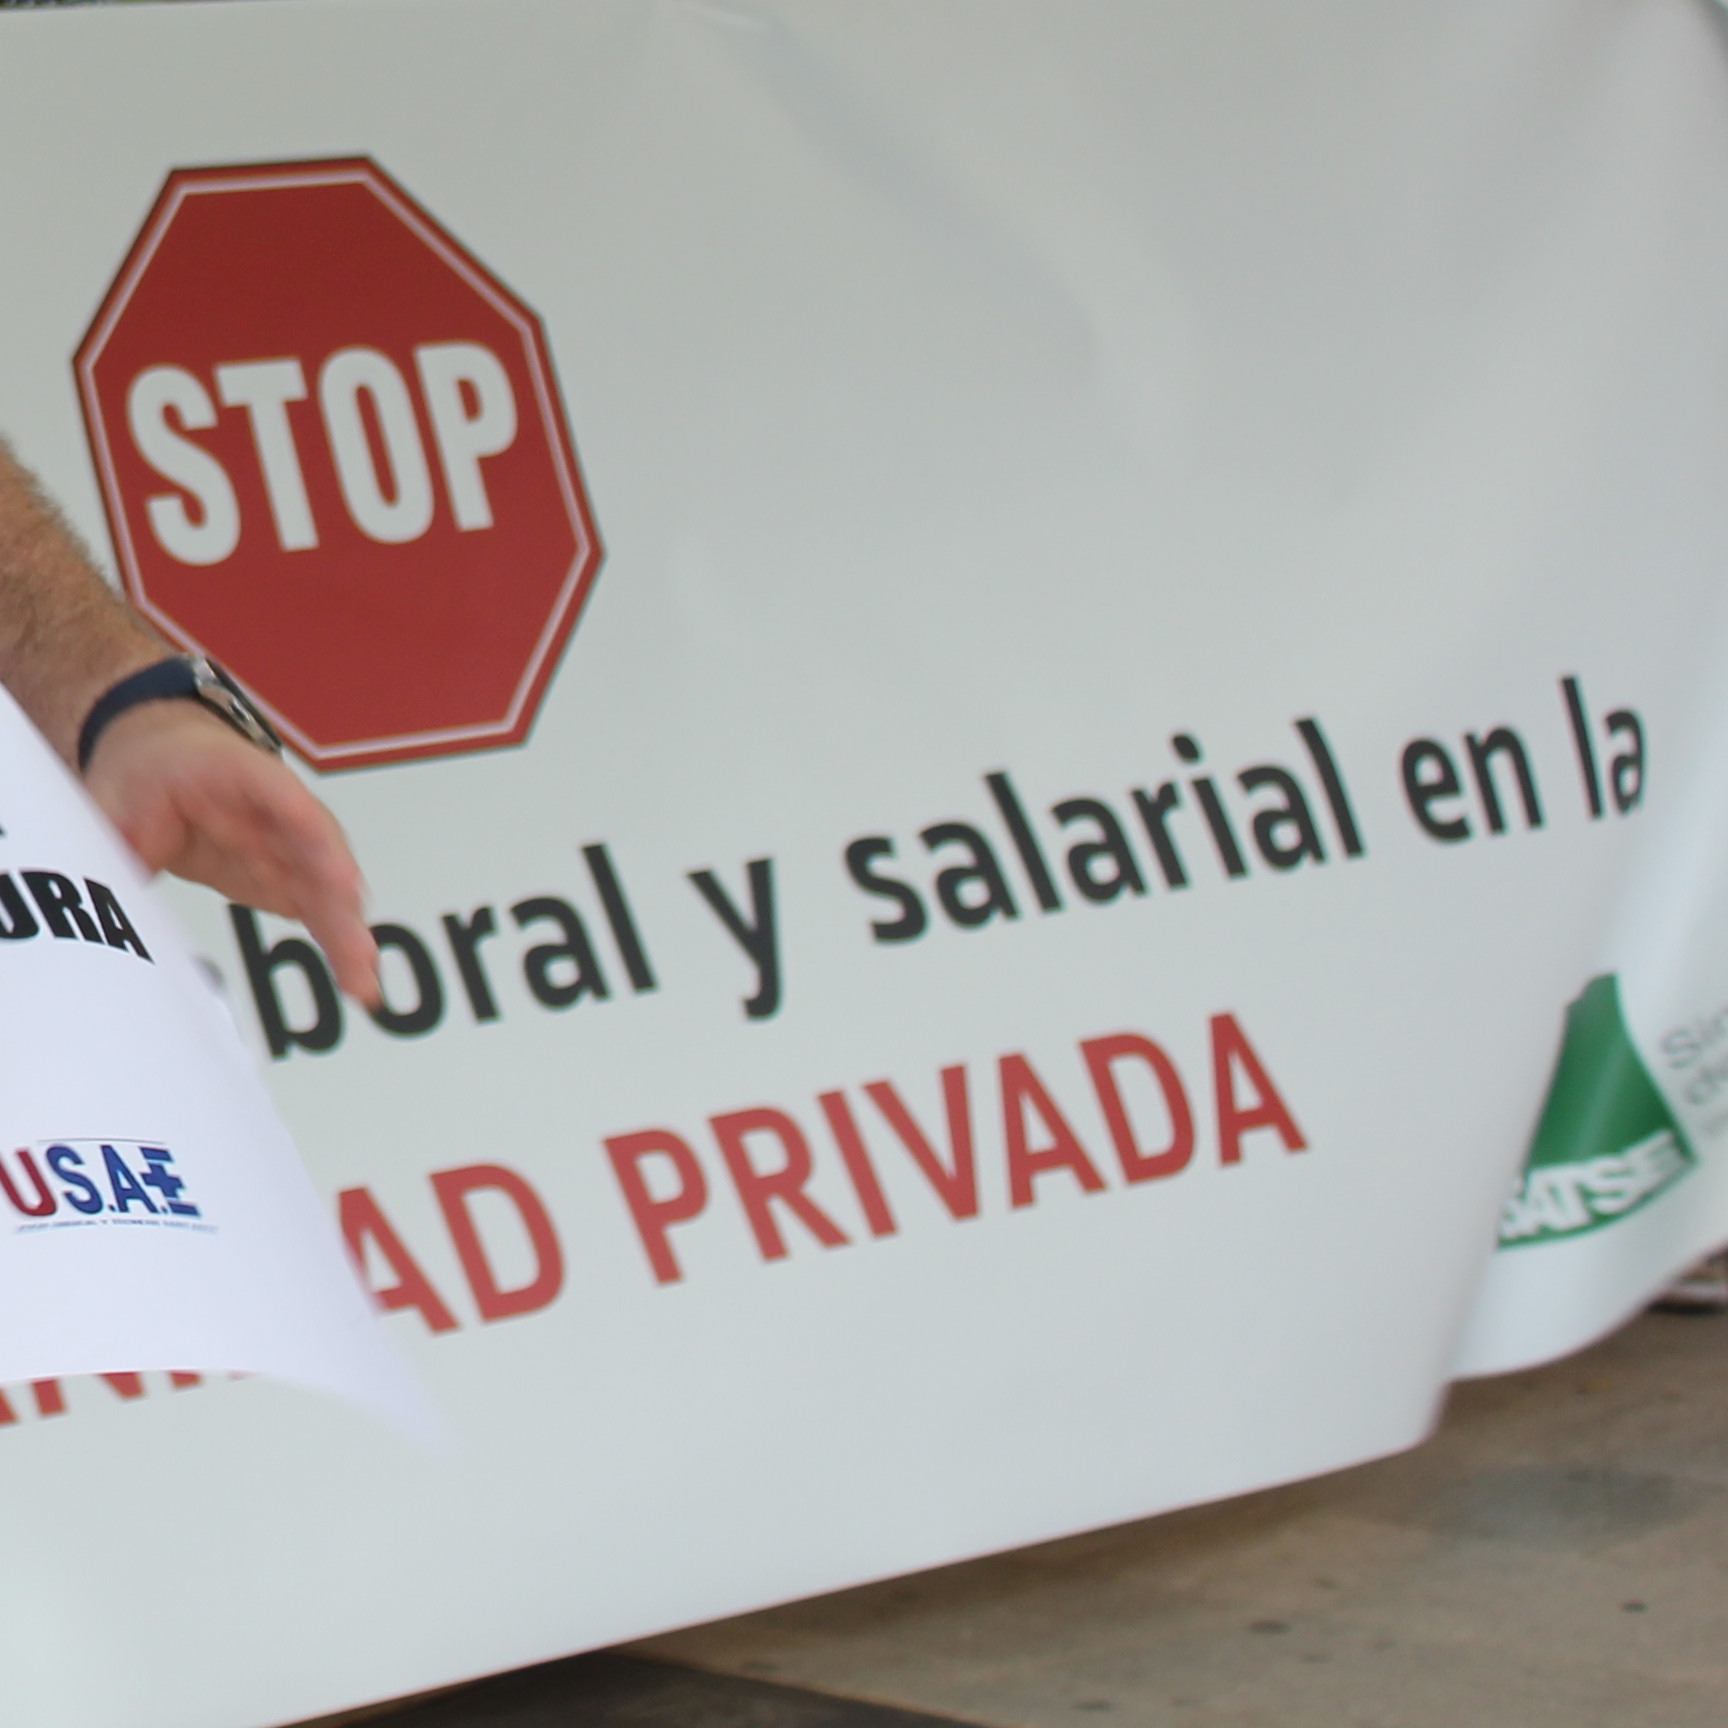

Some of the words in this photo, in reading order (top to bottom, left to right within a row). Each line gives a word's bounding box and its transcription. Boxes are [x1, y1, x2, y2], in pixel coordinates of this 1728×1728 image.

[126, 339, 518, 565] STOP
[194, 844, 658, 1065] boral
[691, 857, 783, 1020] y
[843, 717, 1364, 945] salarial
[1401, 719, 1544, 850] en
[1562, 675, 1647, 819] la
[601, 1012, 1308, 1287] PRIVADA
